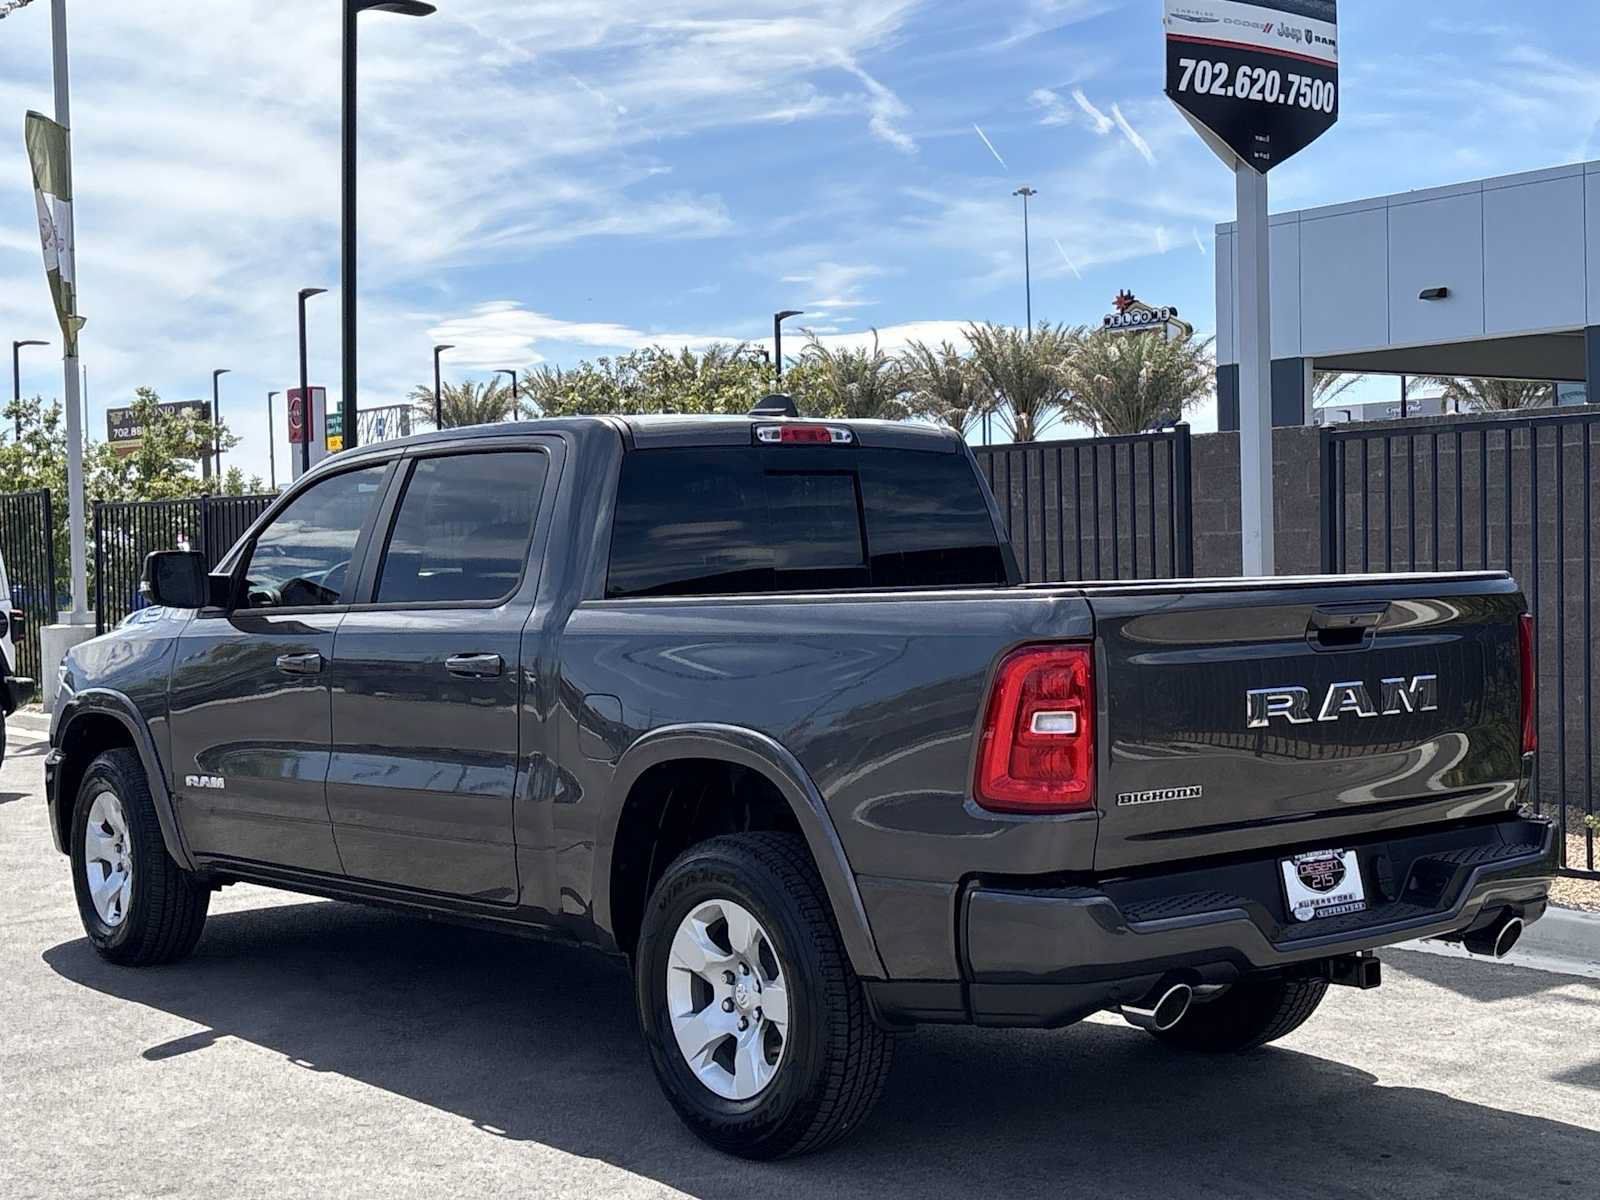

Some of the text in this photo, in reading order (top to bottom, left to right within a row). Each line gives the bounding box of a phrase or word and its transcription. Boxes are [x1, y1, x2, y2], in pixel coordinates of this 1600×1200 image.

[1277, 22, 1302, 43] Jeep
[1314, 35, 1335, 46] RAM
[1178, 58, 1335, 113] 702.620.7500
[1104, 306, 1170, 328] WELCOME
[1246, 674, 1438, 728] RAM
[185, 775, 225, 789] RAM
[1117, 785, 1202, 806] BIGHORN
[1300, 860, 1339, 874] DESERT
[1312, 872, 1335, 888] 215
[1299, 894, 1353, 908] SUPERSTORE
